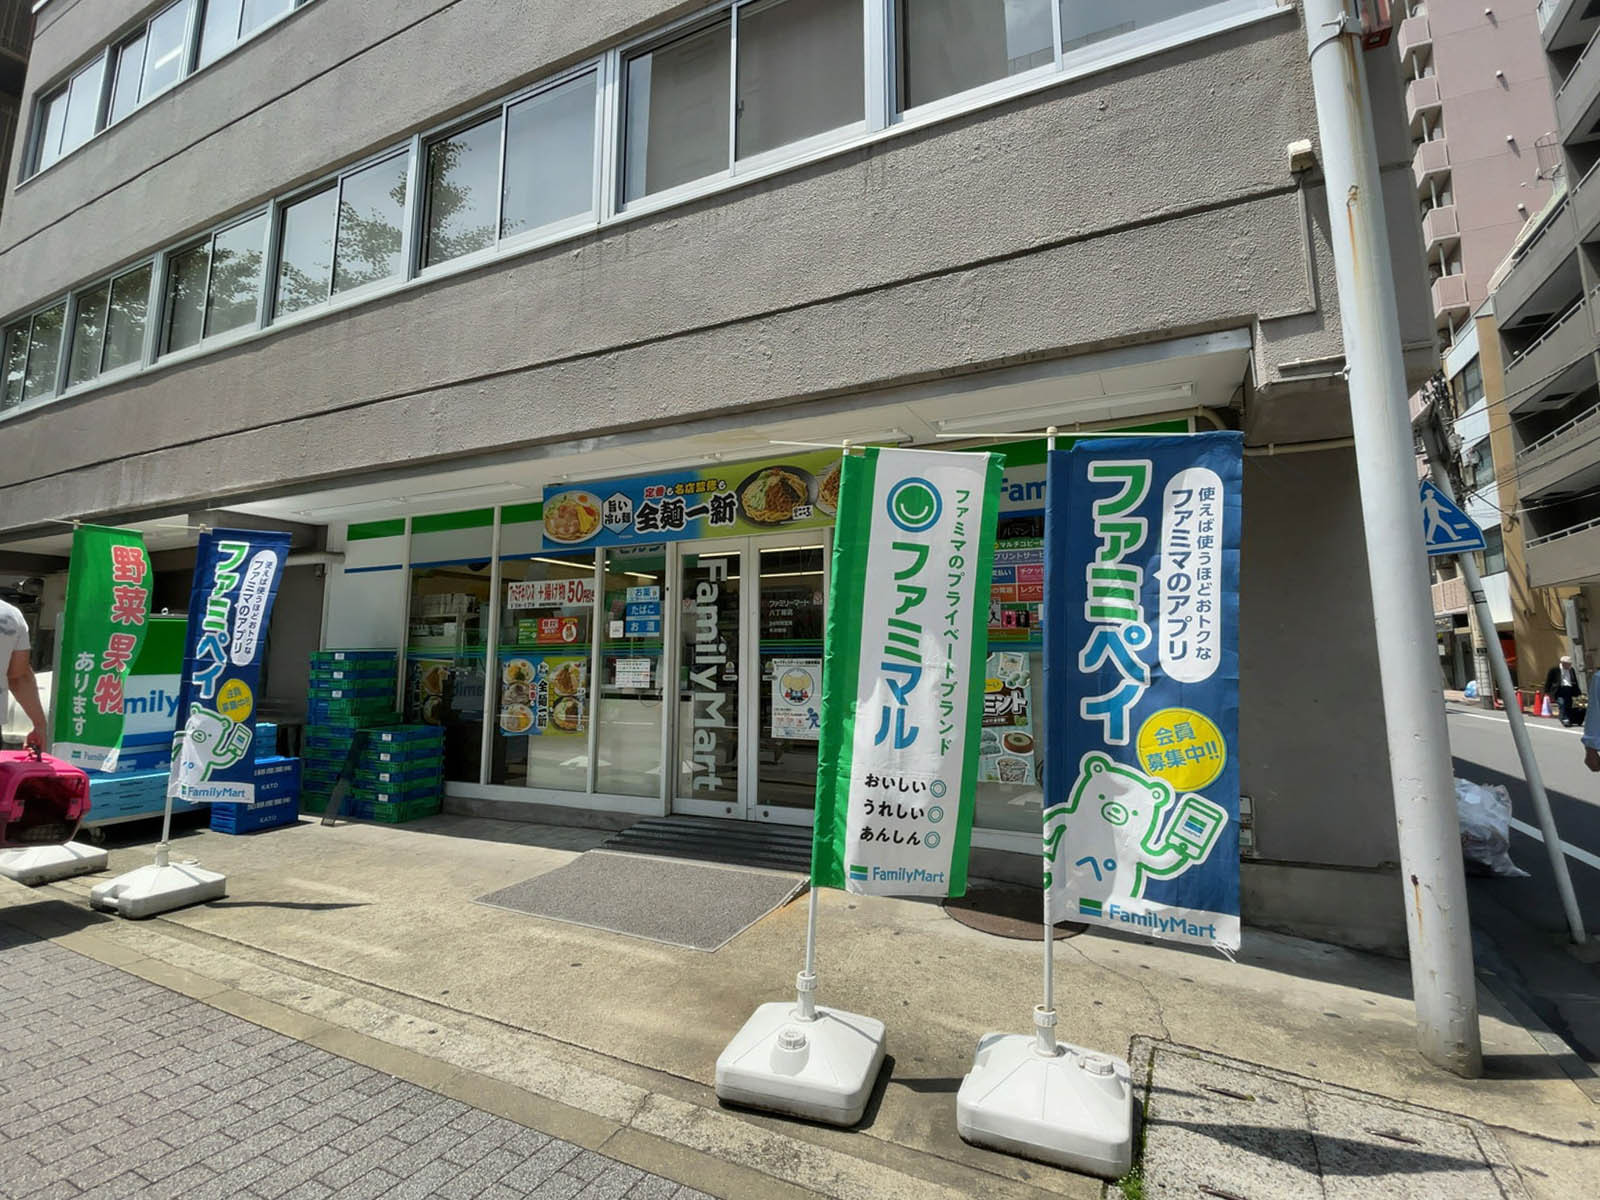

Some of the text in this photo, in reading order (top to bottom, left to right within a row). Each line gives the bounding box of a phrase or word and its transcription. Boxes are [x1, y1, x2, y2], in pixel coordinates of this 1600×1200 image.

[608, 500, 627, 512] 旨い
[636, 493, 736, 533] 全麺一新
[1167, 488, 1194, 661] ファミマのアプリ
[1195, 486, 1216, 661] 使えば使うほどおトクな
[192, 541, 250, 699] ファミペイ
[234, 560, 264, 655] ファミマのアプリ
[631, 604, 656, 615] たばこ
[1080, 460, 1152, 744] ファミペイ
[938, 489, 970, 757] ファミマのプライベートブランド
[874, 541, 930, 750] ファミマル
[71, 651, 96, 736] あります
[690, 558, 728, 791] FamilyMart
[1154, 722, 1197, 747] 会員
[187, 786, 245, 799] FamilyMart
[864, 773, 926, 793] おいしい
[864, 799, 925, 820] うれしい
[860, 826, 921, 846] あんしん
[872, 866, 945, 883] FamilyMart
[1108, 903, 1217, 940] FamilyMart
